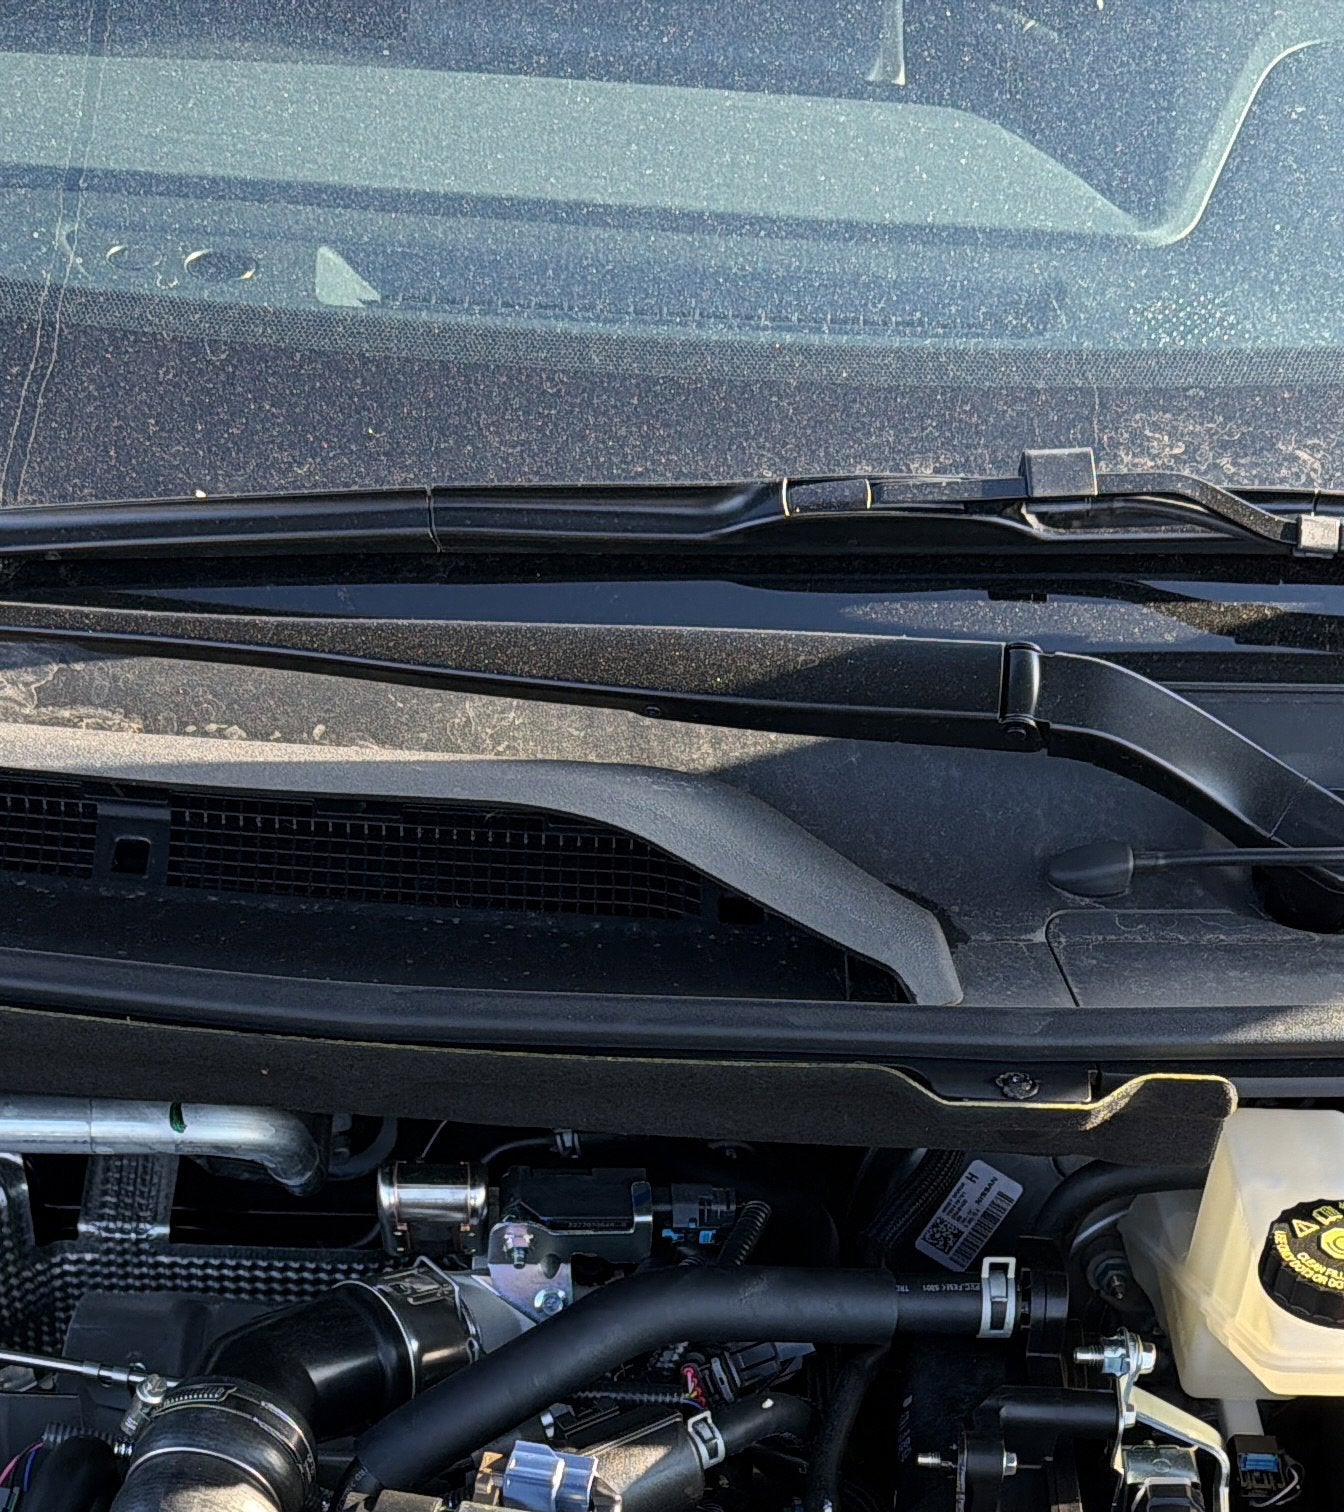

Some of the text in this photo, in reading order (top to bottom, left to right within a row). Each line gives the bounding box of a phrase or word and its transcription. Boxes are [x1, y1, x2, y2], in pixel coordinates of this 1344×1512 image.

[974, 1176, 998, 1206] NISSAN
[1295, 1252, 1327, 1273] CLEAN
[1309, 1273, 1328, 1285] OR
